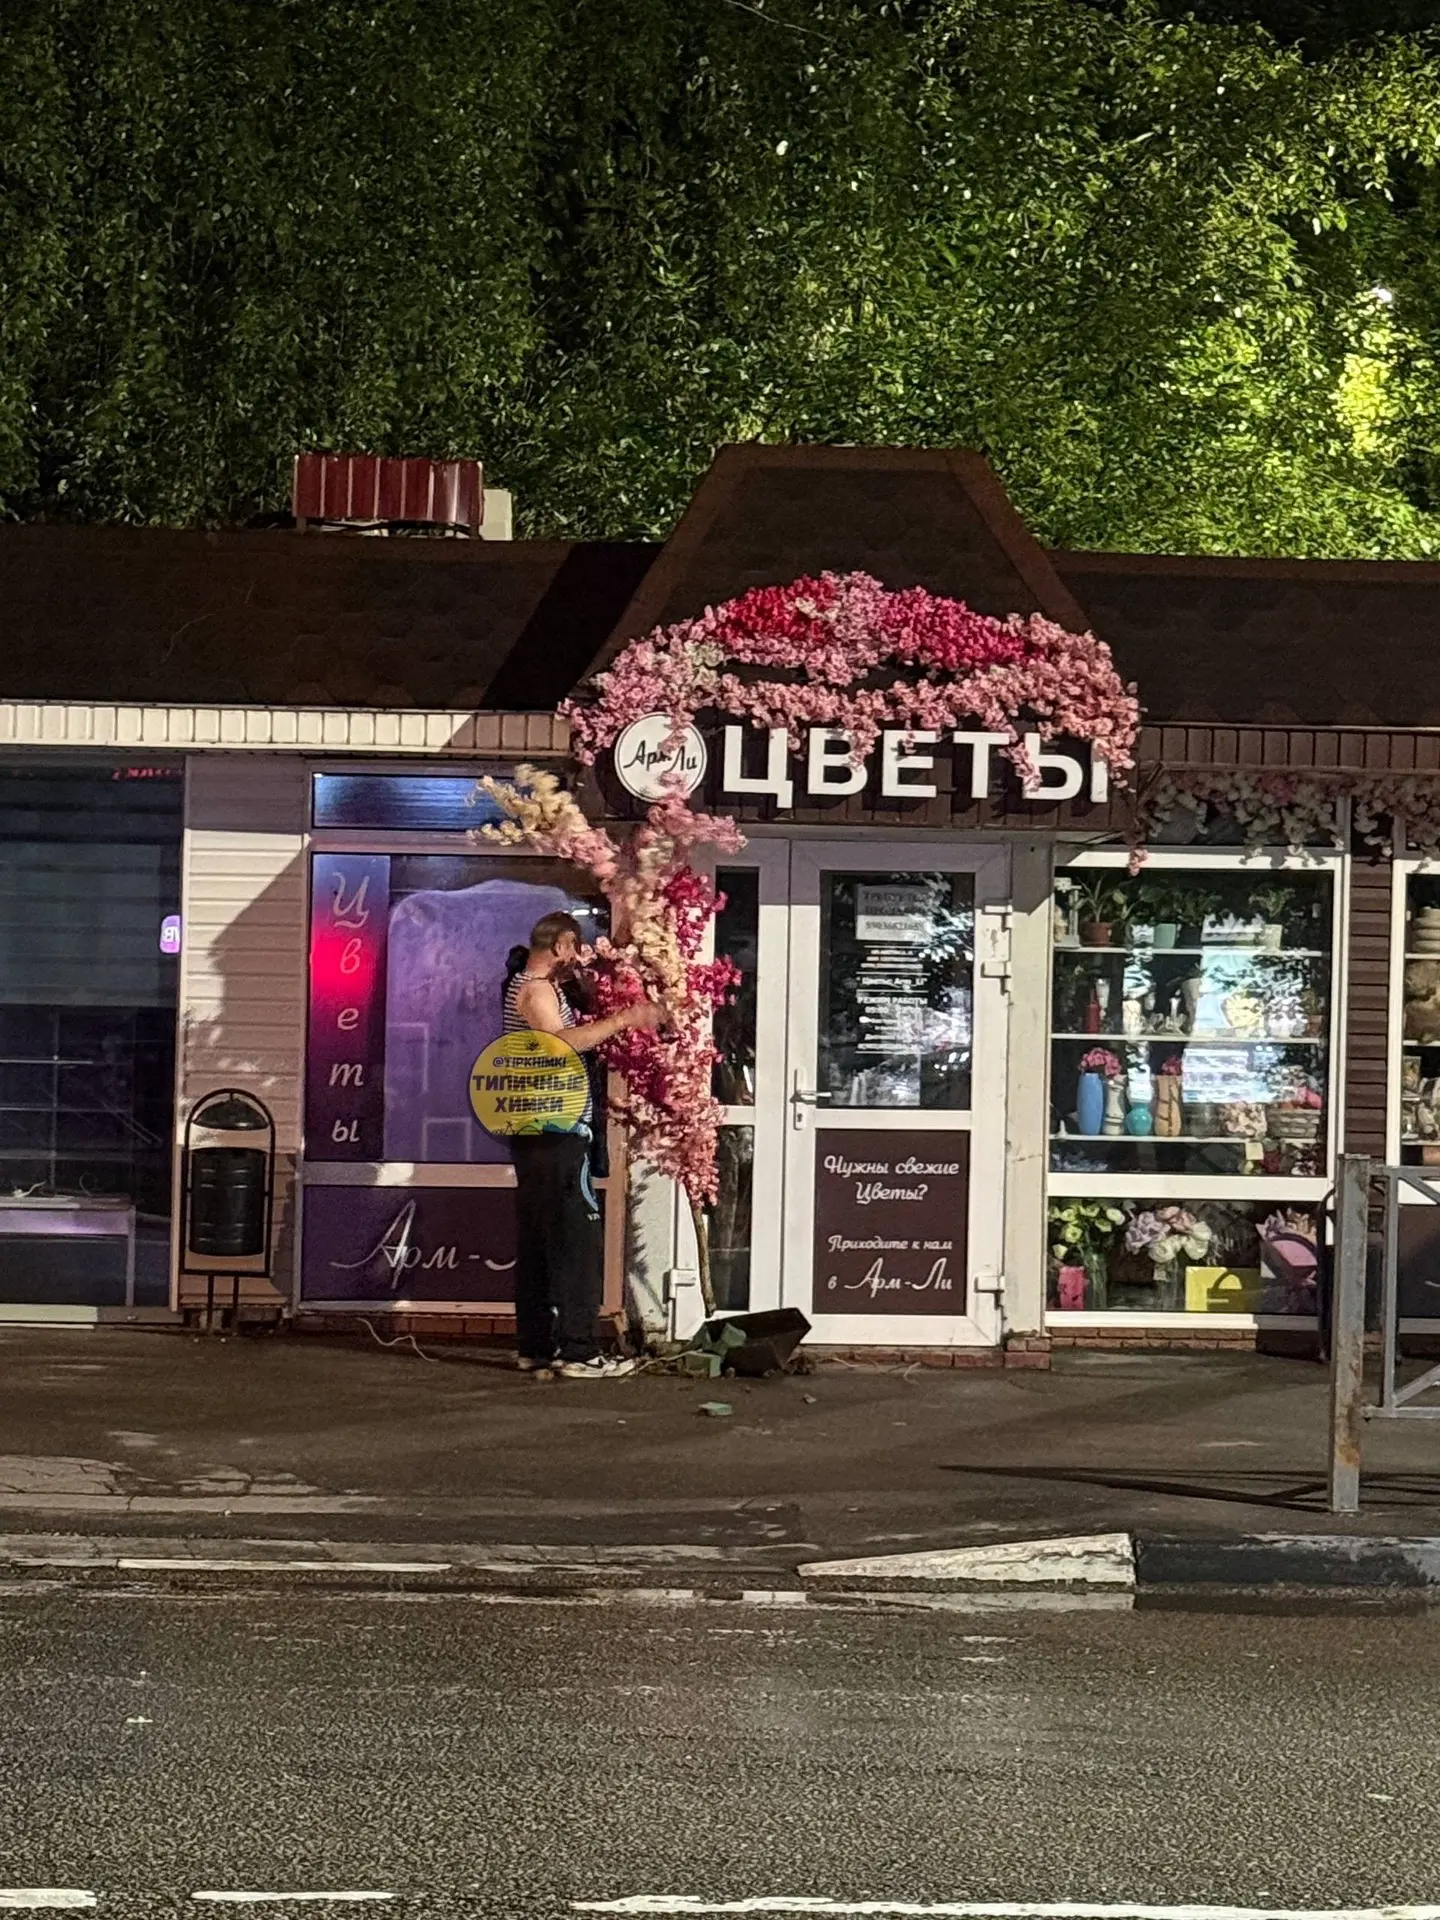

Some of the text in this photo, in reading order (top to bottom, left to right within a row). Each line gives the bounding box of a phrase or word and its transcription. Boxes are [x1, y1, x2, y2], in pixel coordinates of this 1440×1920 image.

[723, 725, 1109, 809] ЦВЕТЫ
[824, 1155, 960, 1178] Нужны свежие
[856, 1182, 928, 1204] Цветы?
[330, 1200, 516, 1289] Арм-
[828, 1235, 953, 1252] Приходите к нам
[828, 1275, 838, 1290] в
